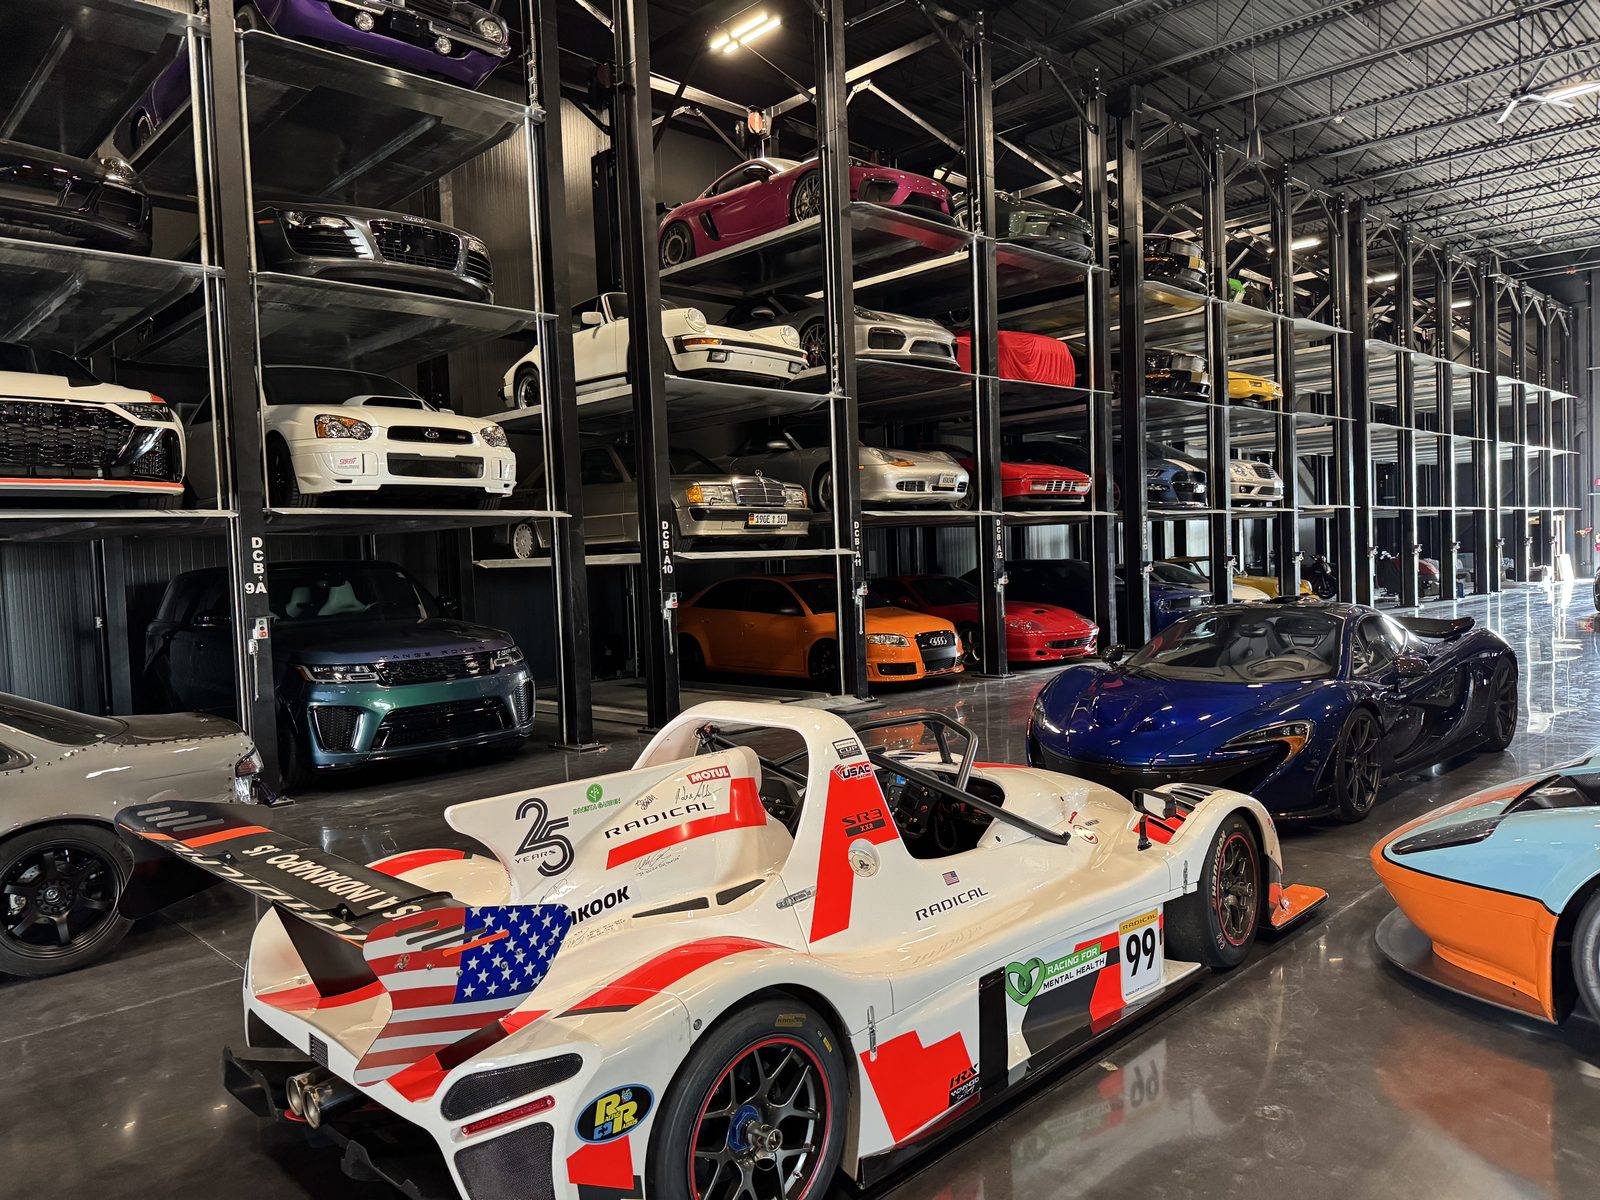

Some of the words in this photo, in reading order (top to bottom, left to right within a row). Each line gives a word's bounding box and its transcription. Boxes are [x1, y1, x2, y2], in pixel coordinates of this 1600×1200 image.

[244, 582, 268, 594] 9A
[691, 767, 729, 783] MOTUL
[842, 764, 871, 779] USAC
[603, 801, 716, 840] RADICAL
[841, 808, 883, 827] SR3
[514, 797, 575, 878] 25
[514, 848, 557, 865] YEARS
[915, 887, 989, 922] RADICAL
[1122, 914, 1157, 931] RADICAL
[1047, 954, 1079, 976] RACING
[1081, 946, 1098, 962] FOR
[1126, 927, 1156, 978] 99
[1043, 973, 1074, 991] MENTAL
[1076, 957, 1105, 976] HEALTH
[950, 1062, 979, 1089] HRX
